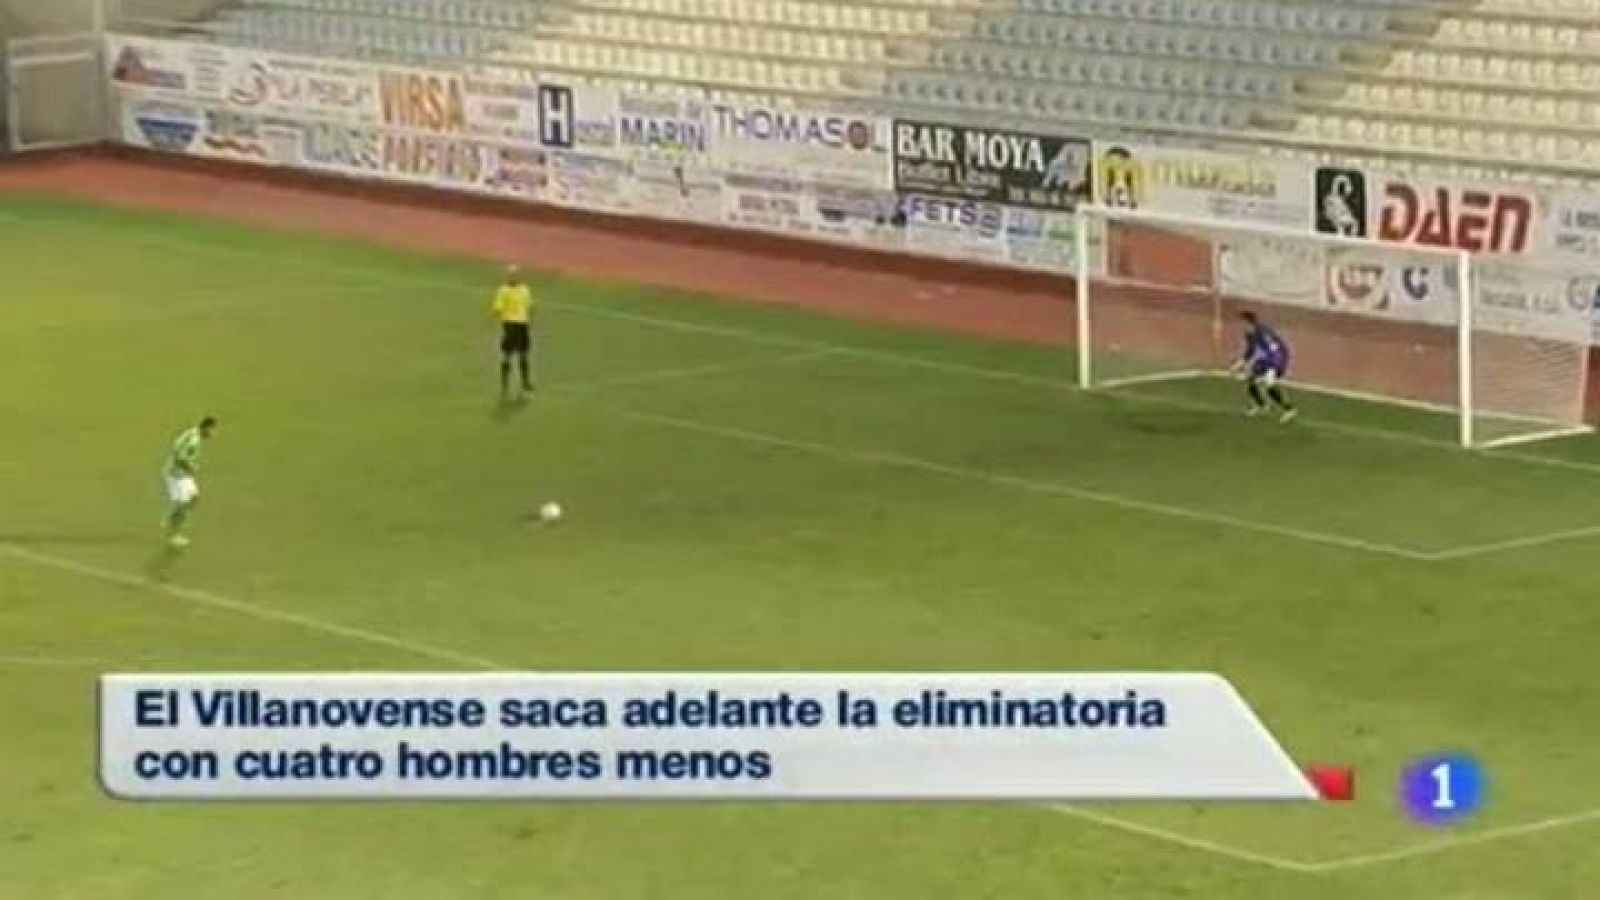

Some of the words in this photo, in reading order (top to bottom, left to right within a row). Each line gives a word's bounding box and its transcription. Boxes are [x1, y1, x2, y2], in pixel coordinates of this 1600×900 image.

[379, 72, 465, 133] VIRSA
[541, 91, 570, 142] H
[620, 116, 705, 152] MARIN
[713, 104, 888, 153] THOMASOL
[897, 124, 956, 162] BAR
[964, 130, 1045, 173] MOYA
